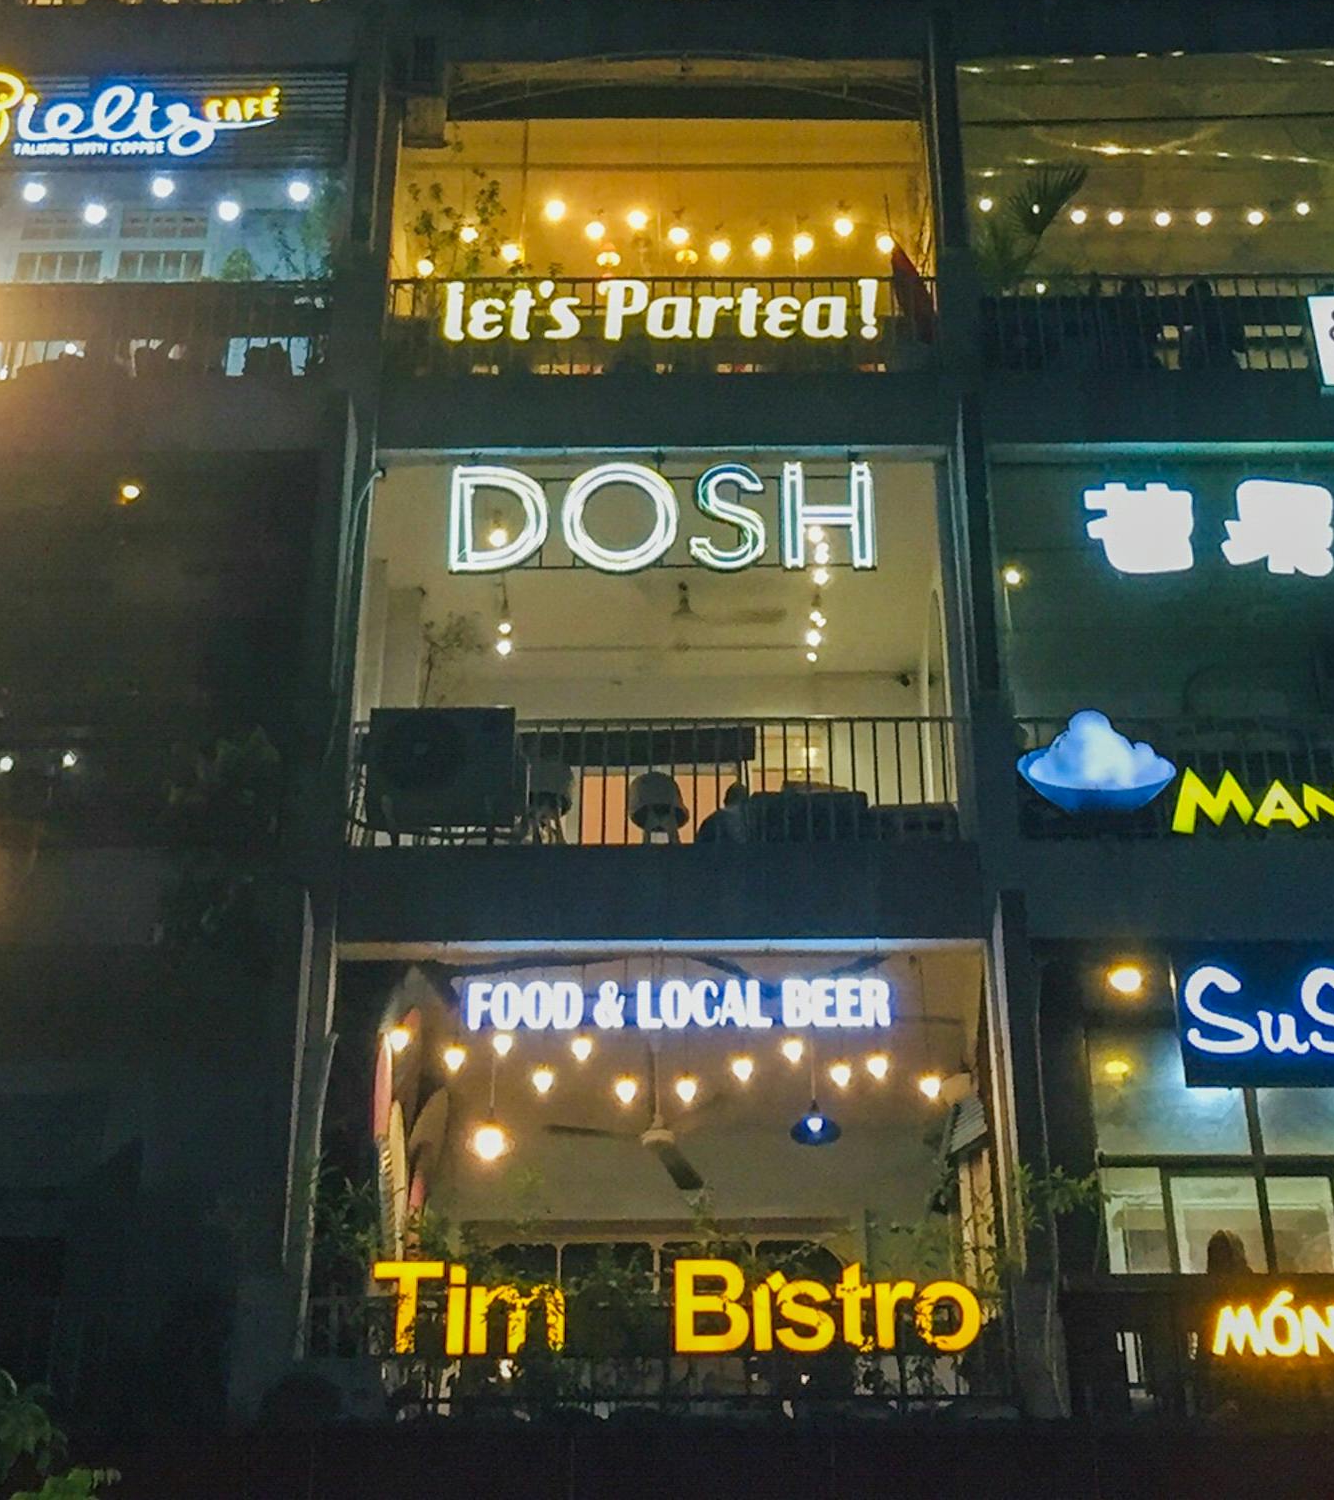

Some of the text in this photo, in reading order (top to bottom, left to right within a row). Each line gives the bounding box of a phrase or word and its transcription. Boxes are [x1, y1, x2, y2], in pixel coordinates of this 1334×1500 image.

[444, 280, 581, 342] let's
[447, 461, 877, 574] DOSH
[467, 977, 892, 1032] FOOD & LOCAL BEER
[373, 1257, 982, 1357] Tim Bistro
